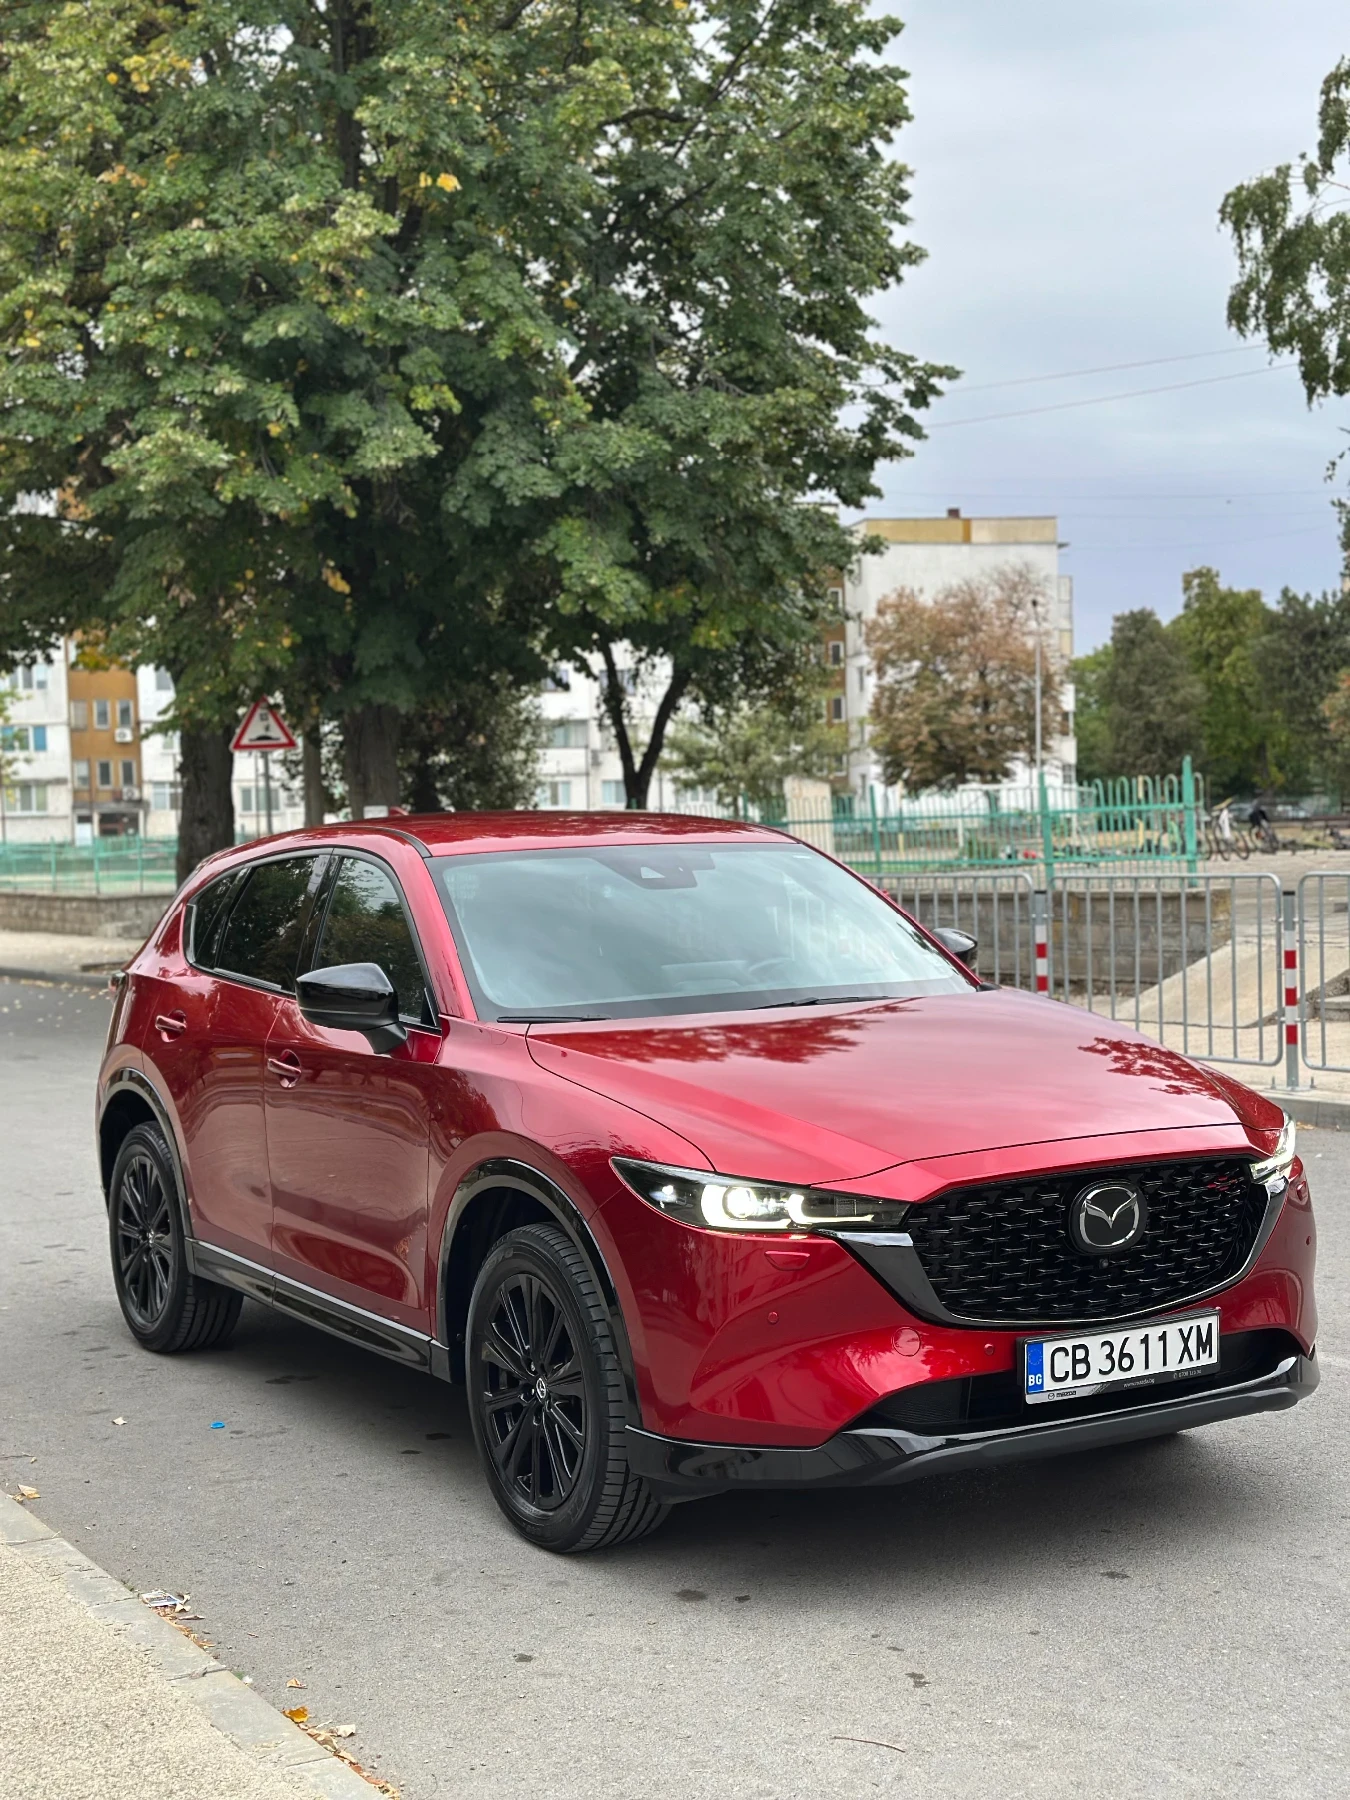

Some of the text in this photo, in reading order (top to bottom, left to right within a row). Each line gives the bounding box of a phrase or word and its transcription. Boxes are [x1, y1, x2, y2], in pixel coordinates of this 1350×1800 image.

[1050, 1323, 1213, 1383] CB 3611 XM
[1028, 1374, 1042, 1387] BG
